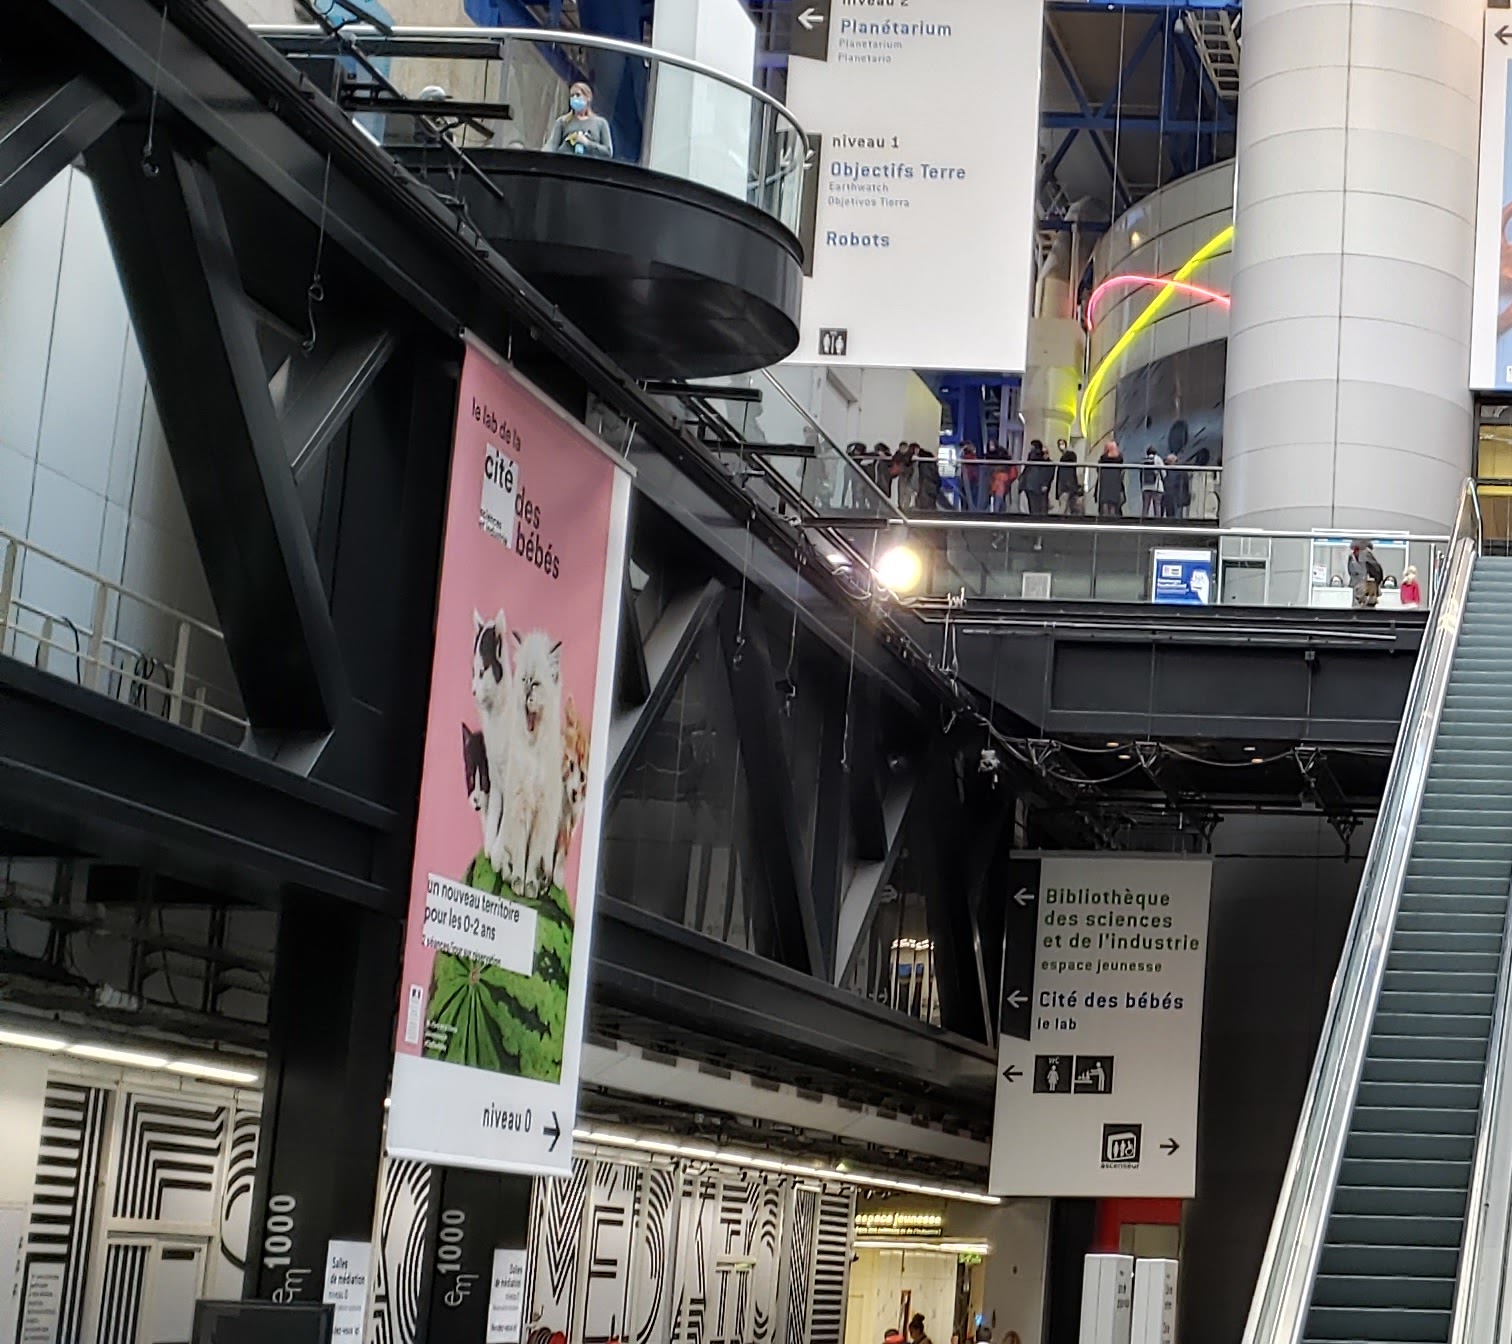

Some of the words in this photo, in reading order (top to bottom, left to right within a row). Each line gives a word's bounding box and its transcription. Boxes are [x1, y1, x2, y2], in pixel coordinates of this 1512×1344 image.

[841, 19, 952, 37] Planétarium
[831, 133, 886, 149] niveau
[891, 136, 899, 149] 1
[831, 161, 914, 182] Objectifs
[920, 163, 966, 180] Terre
[829, 182, 889, 193] Earthwatch
[828, 196, 877, 208] Objetivos
[880, 197, 910, 208] Tierra
[826, 231, 890, 247] Robots
[472, 395, 481, 422] le
[483, 405, 498, 434] lab
[499, 420, 511, 445] de
[513, 427, 521, 452] la
[485, 449, 514, 493] cité
[515, 486, 541, 530] des
[515, 521, 560, 580] bébés
[427, 879, 440, 896] un
[441, 883, 480, 910] nouveau
[481, 894, 520, 923] territoire
[1046, 888, 1170, 911] Bibliothèque
[424, 906, 447, 925] pour
[448, 907, 462, 931] les
[463, 915, 480, 936] 0-2
[480, 923, 496, 941] ans
[1044, 910, 1078, 927] des
[1086, 911, 1173, 929] sciences
[1043, 935, 1062, 949] et
[1069, 932, 1092, 949] de
[1098, 933, 1200, 951] l'industrie
[1041, 960, 1092, 974] espace
[1096, 959, 1162, 975] jeunesse
[1039, 990, 1077, 1008] Cité
[1084, 991, 1118, 1009] des
[1126, 992, 1184, 1010] bébés
[1037, 1017, 1050, 1030] le
[1055, 1017, 1077, 1031] lab
[482, 1102, 522, 1132] niveau
[524, 1108, 531, 1133] 0
[855, 1214, 893, 1227] espace
[263, 1194, 296, 1269] 1000
[437, 1209, 465, 1275] 1000
